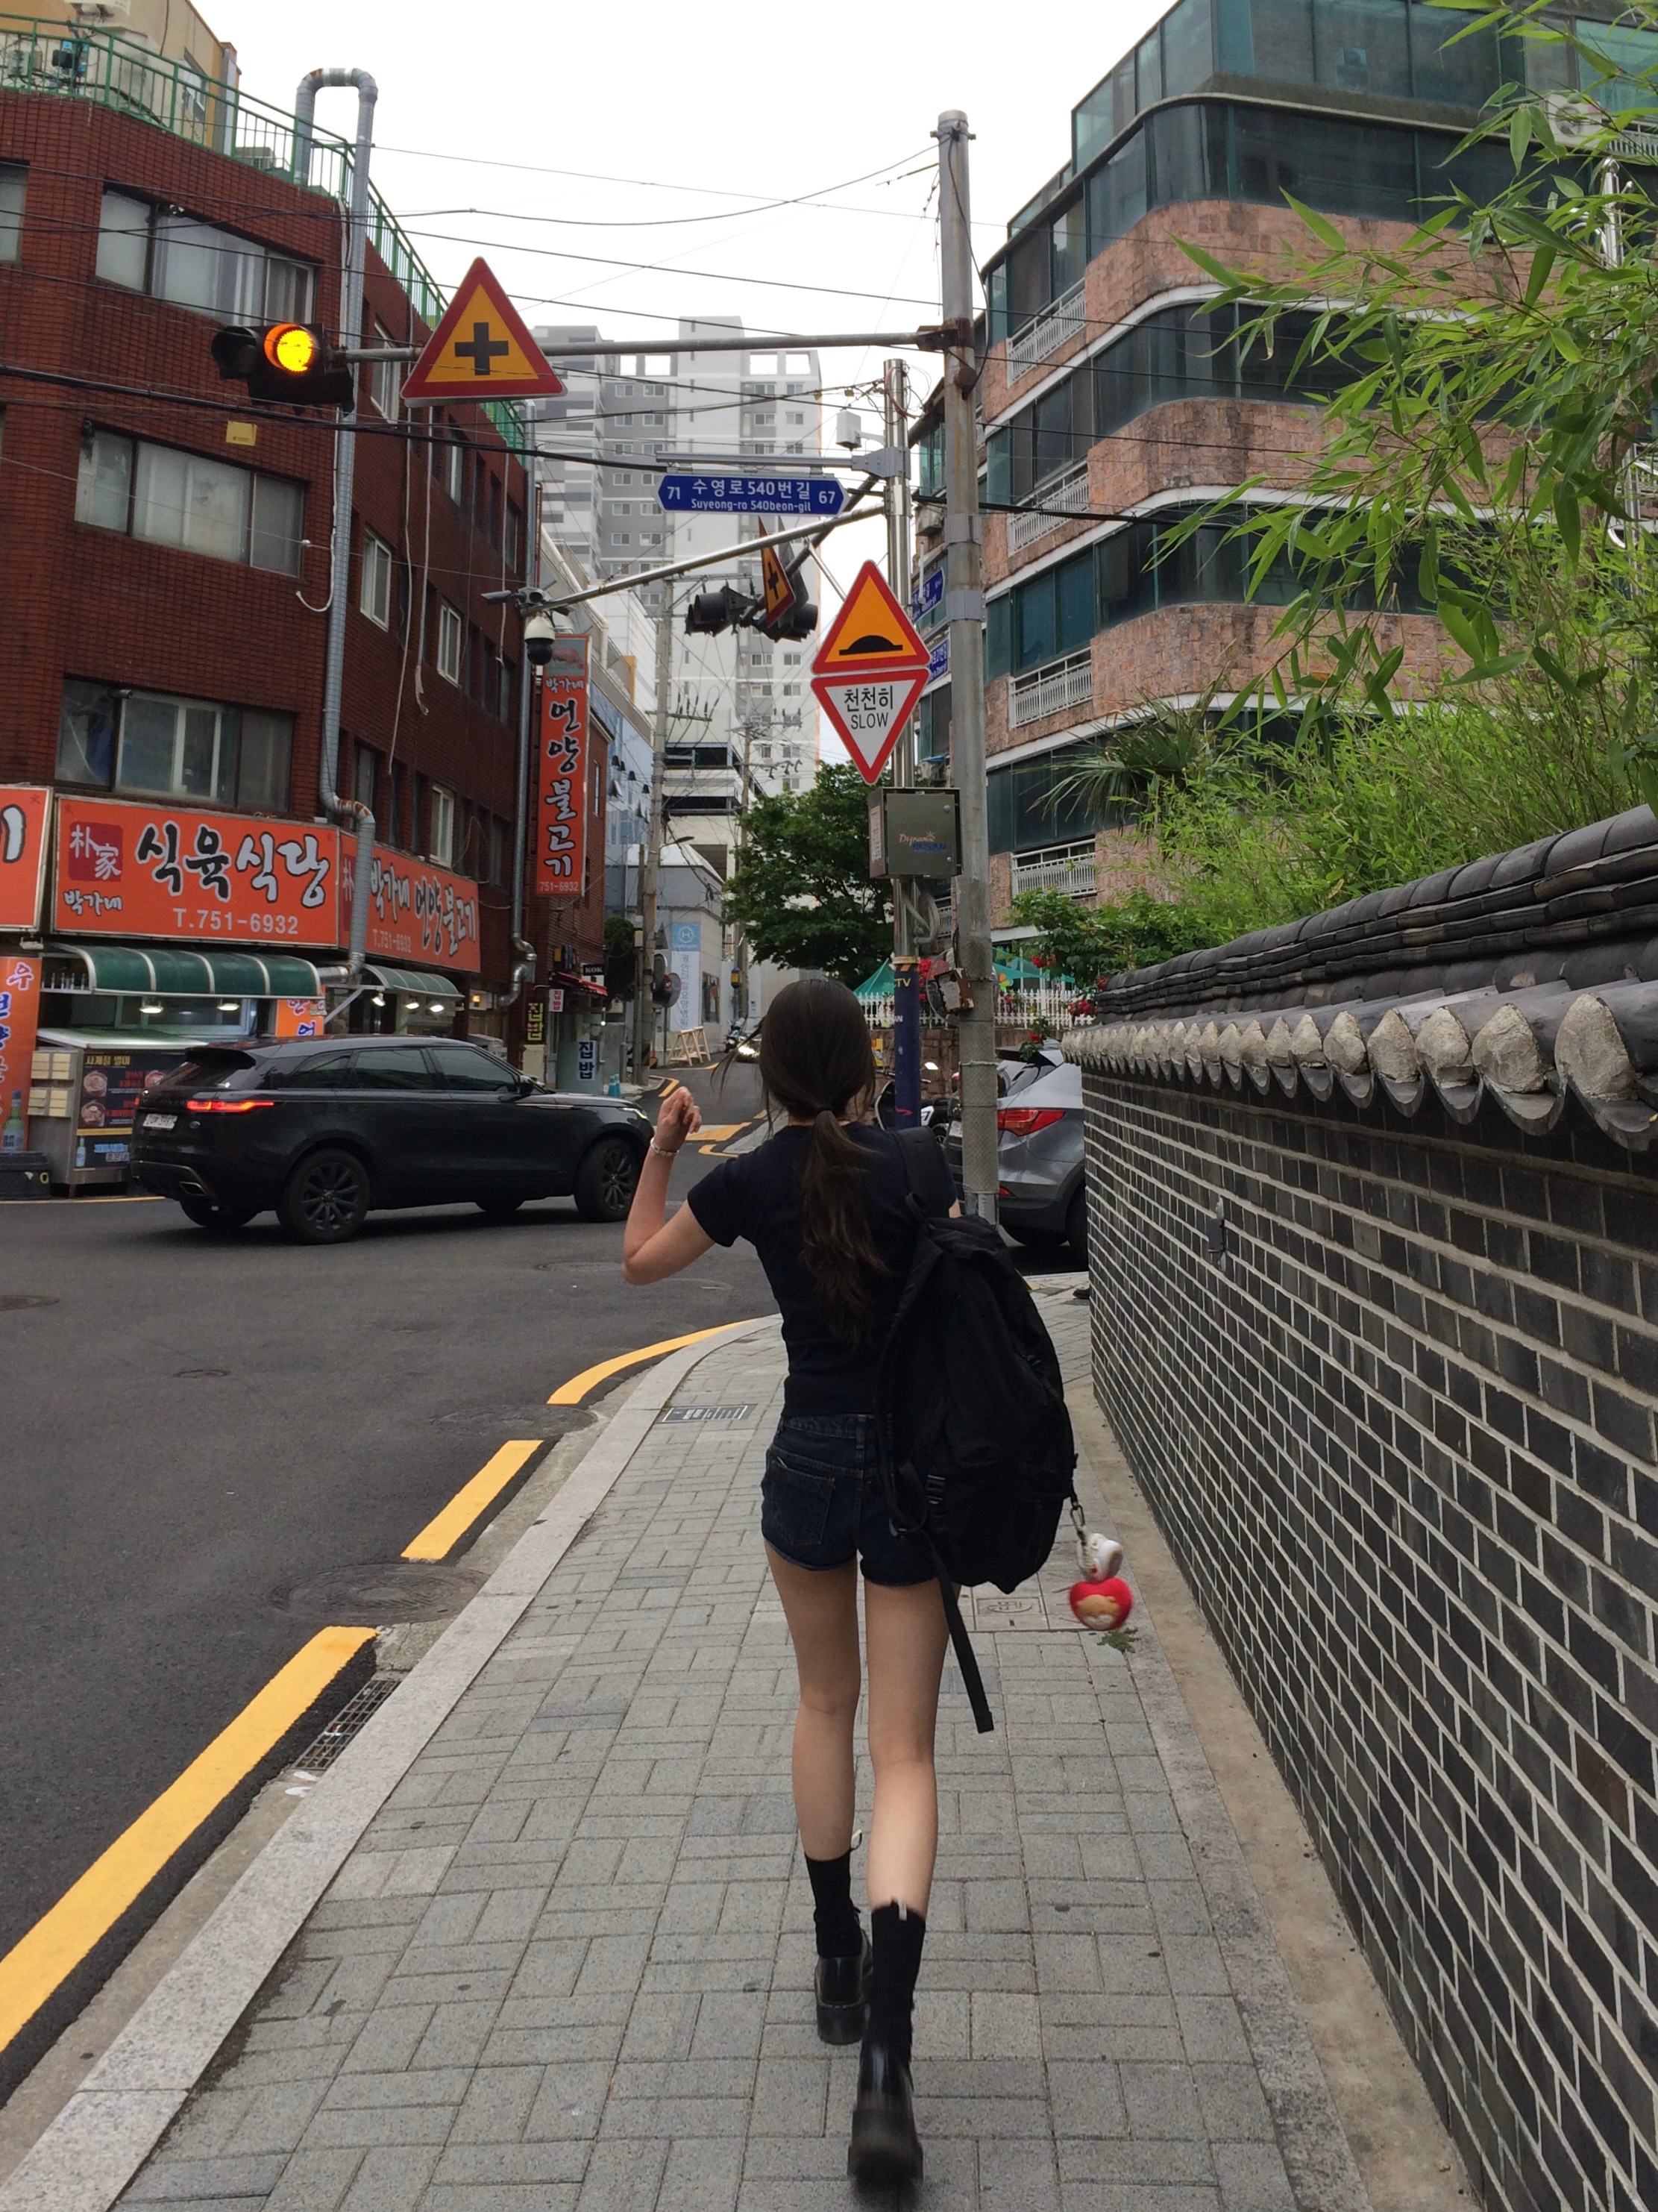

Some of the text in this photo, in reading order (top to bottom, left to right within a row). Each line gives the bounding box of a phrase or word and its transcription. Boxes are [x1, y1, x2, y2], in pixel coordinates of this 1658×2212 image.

[667, 479, 835, 504] 71 수영로540번길 67
[691, 498, 811, 513] Suyeong-ro 540beon-gil
[546, 677, 584, 694] 박가네
[844, 685, 893, 712] 천천히
[851, 712, 888, 730] SLOW
[135, 820, 330, 909] 식육식당
[540, 881, 579, 892] 751-6932
[63, 889, 122, 916] 박가네
[173, 907, 298, 935] T.751-6932
[894, 978, 911, 987] TV
[527, 1003, 544, 1041] 집밥
[579, 1041, 594, 1080] 집밥
